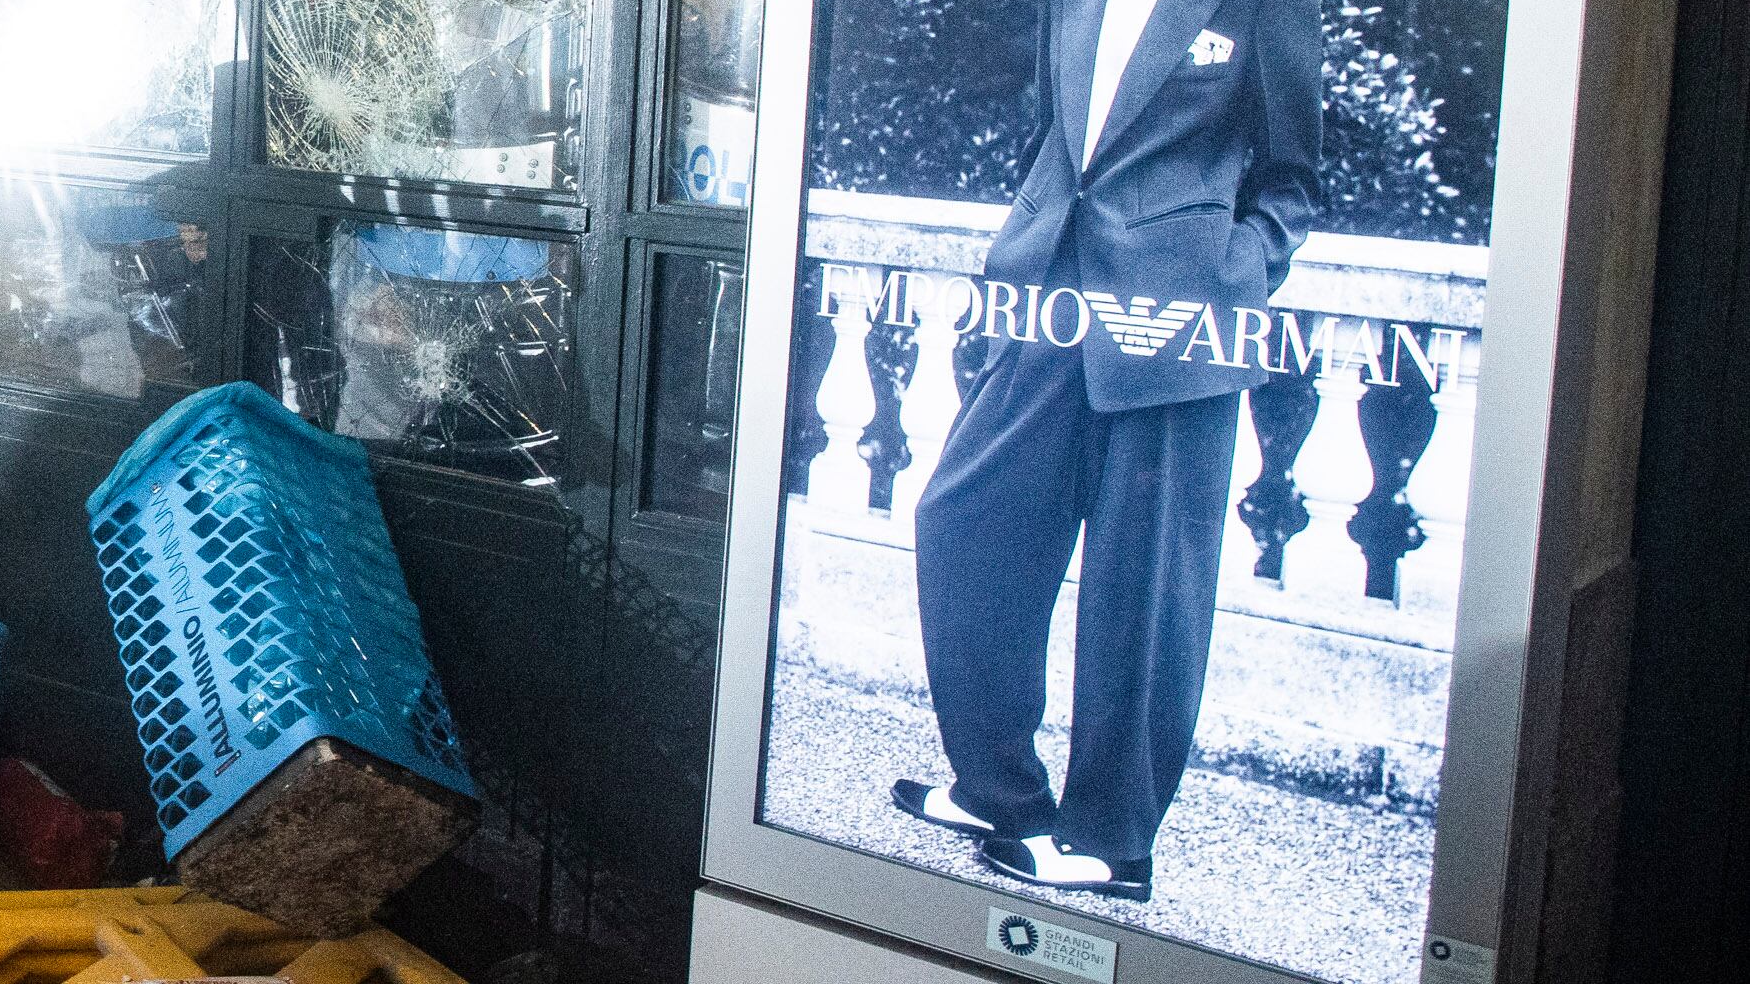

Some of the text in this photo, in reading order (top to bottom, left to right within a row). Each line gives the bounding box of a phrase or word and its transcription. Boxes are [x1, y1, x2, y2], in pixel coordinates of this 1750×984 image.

[816, 262, 1468, 394] EMPORIO ARMANI
[150, 488, 195, 605] ALUMINUM
[183, 615, 234, 759] ALLUMINIO
[1043, 951, 1088, 972] RETAIL
[1044, 929, 1095, 951] GRANDI
[1044, 940, 1105, 965] STAZIONI
